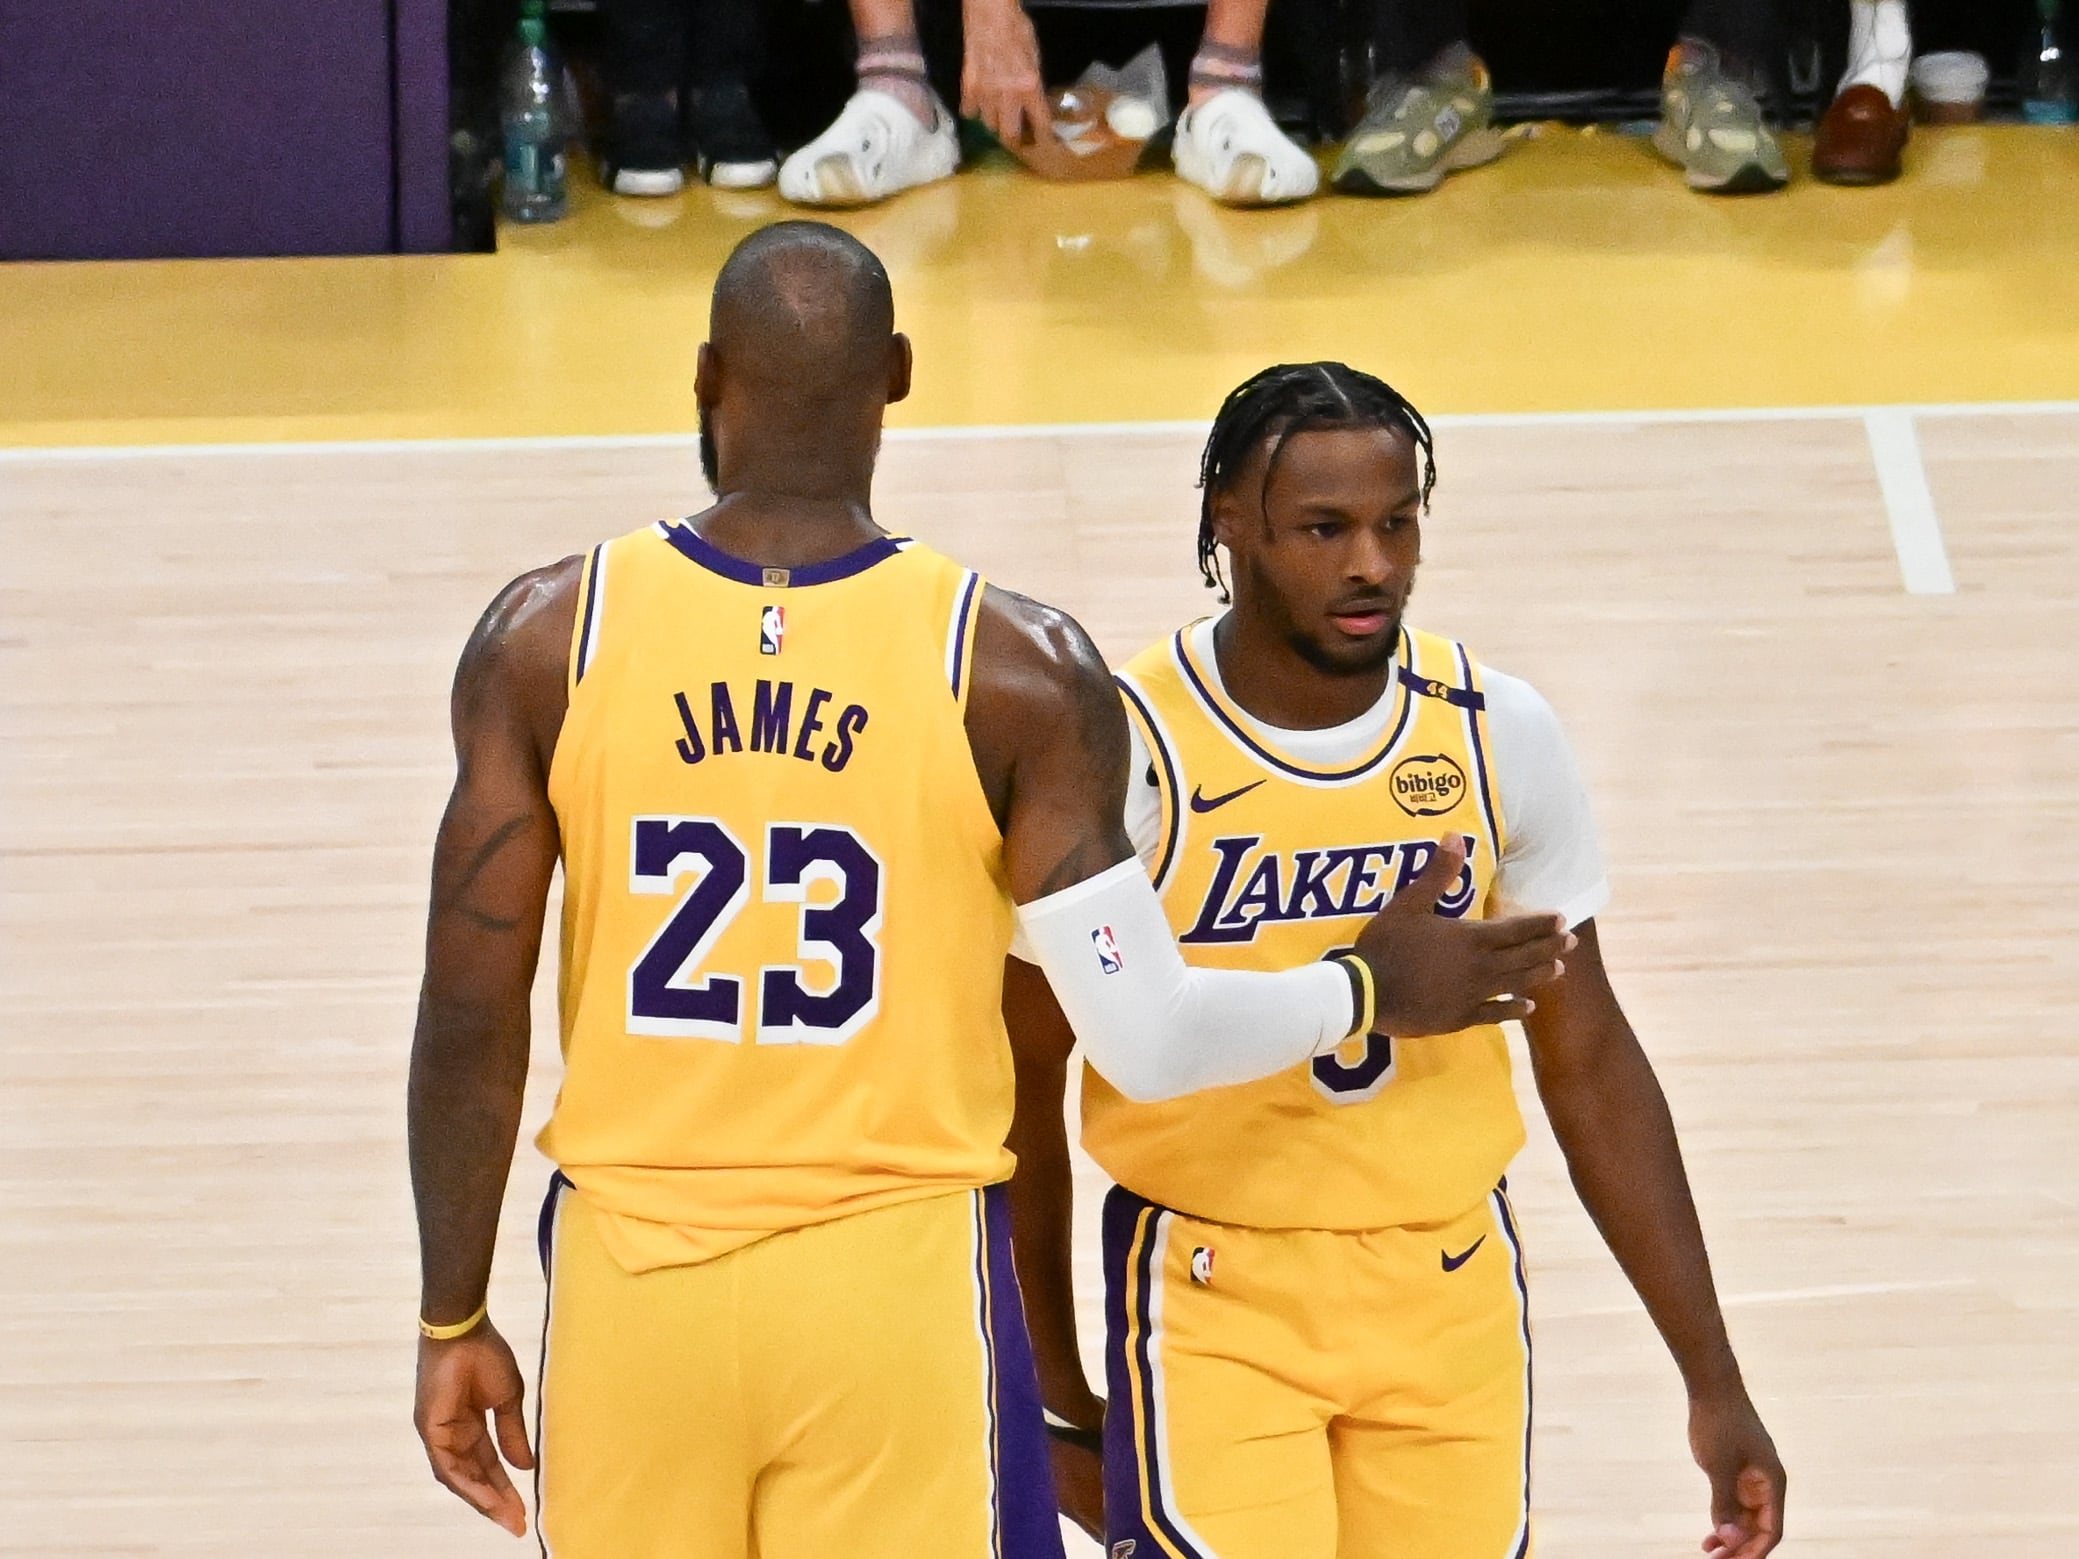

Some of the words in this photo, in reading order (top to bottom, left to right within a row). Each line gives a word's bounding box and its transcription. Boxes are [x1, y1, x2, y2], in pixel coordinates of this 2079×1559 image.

[673, 679, 868, 772] JAMES
[1395, 771, 1461, 796] bibigo
[626, 814, 885, 1045] 23
